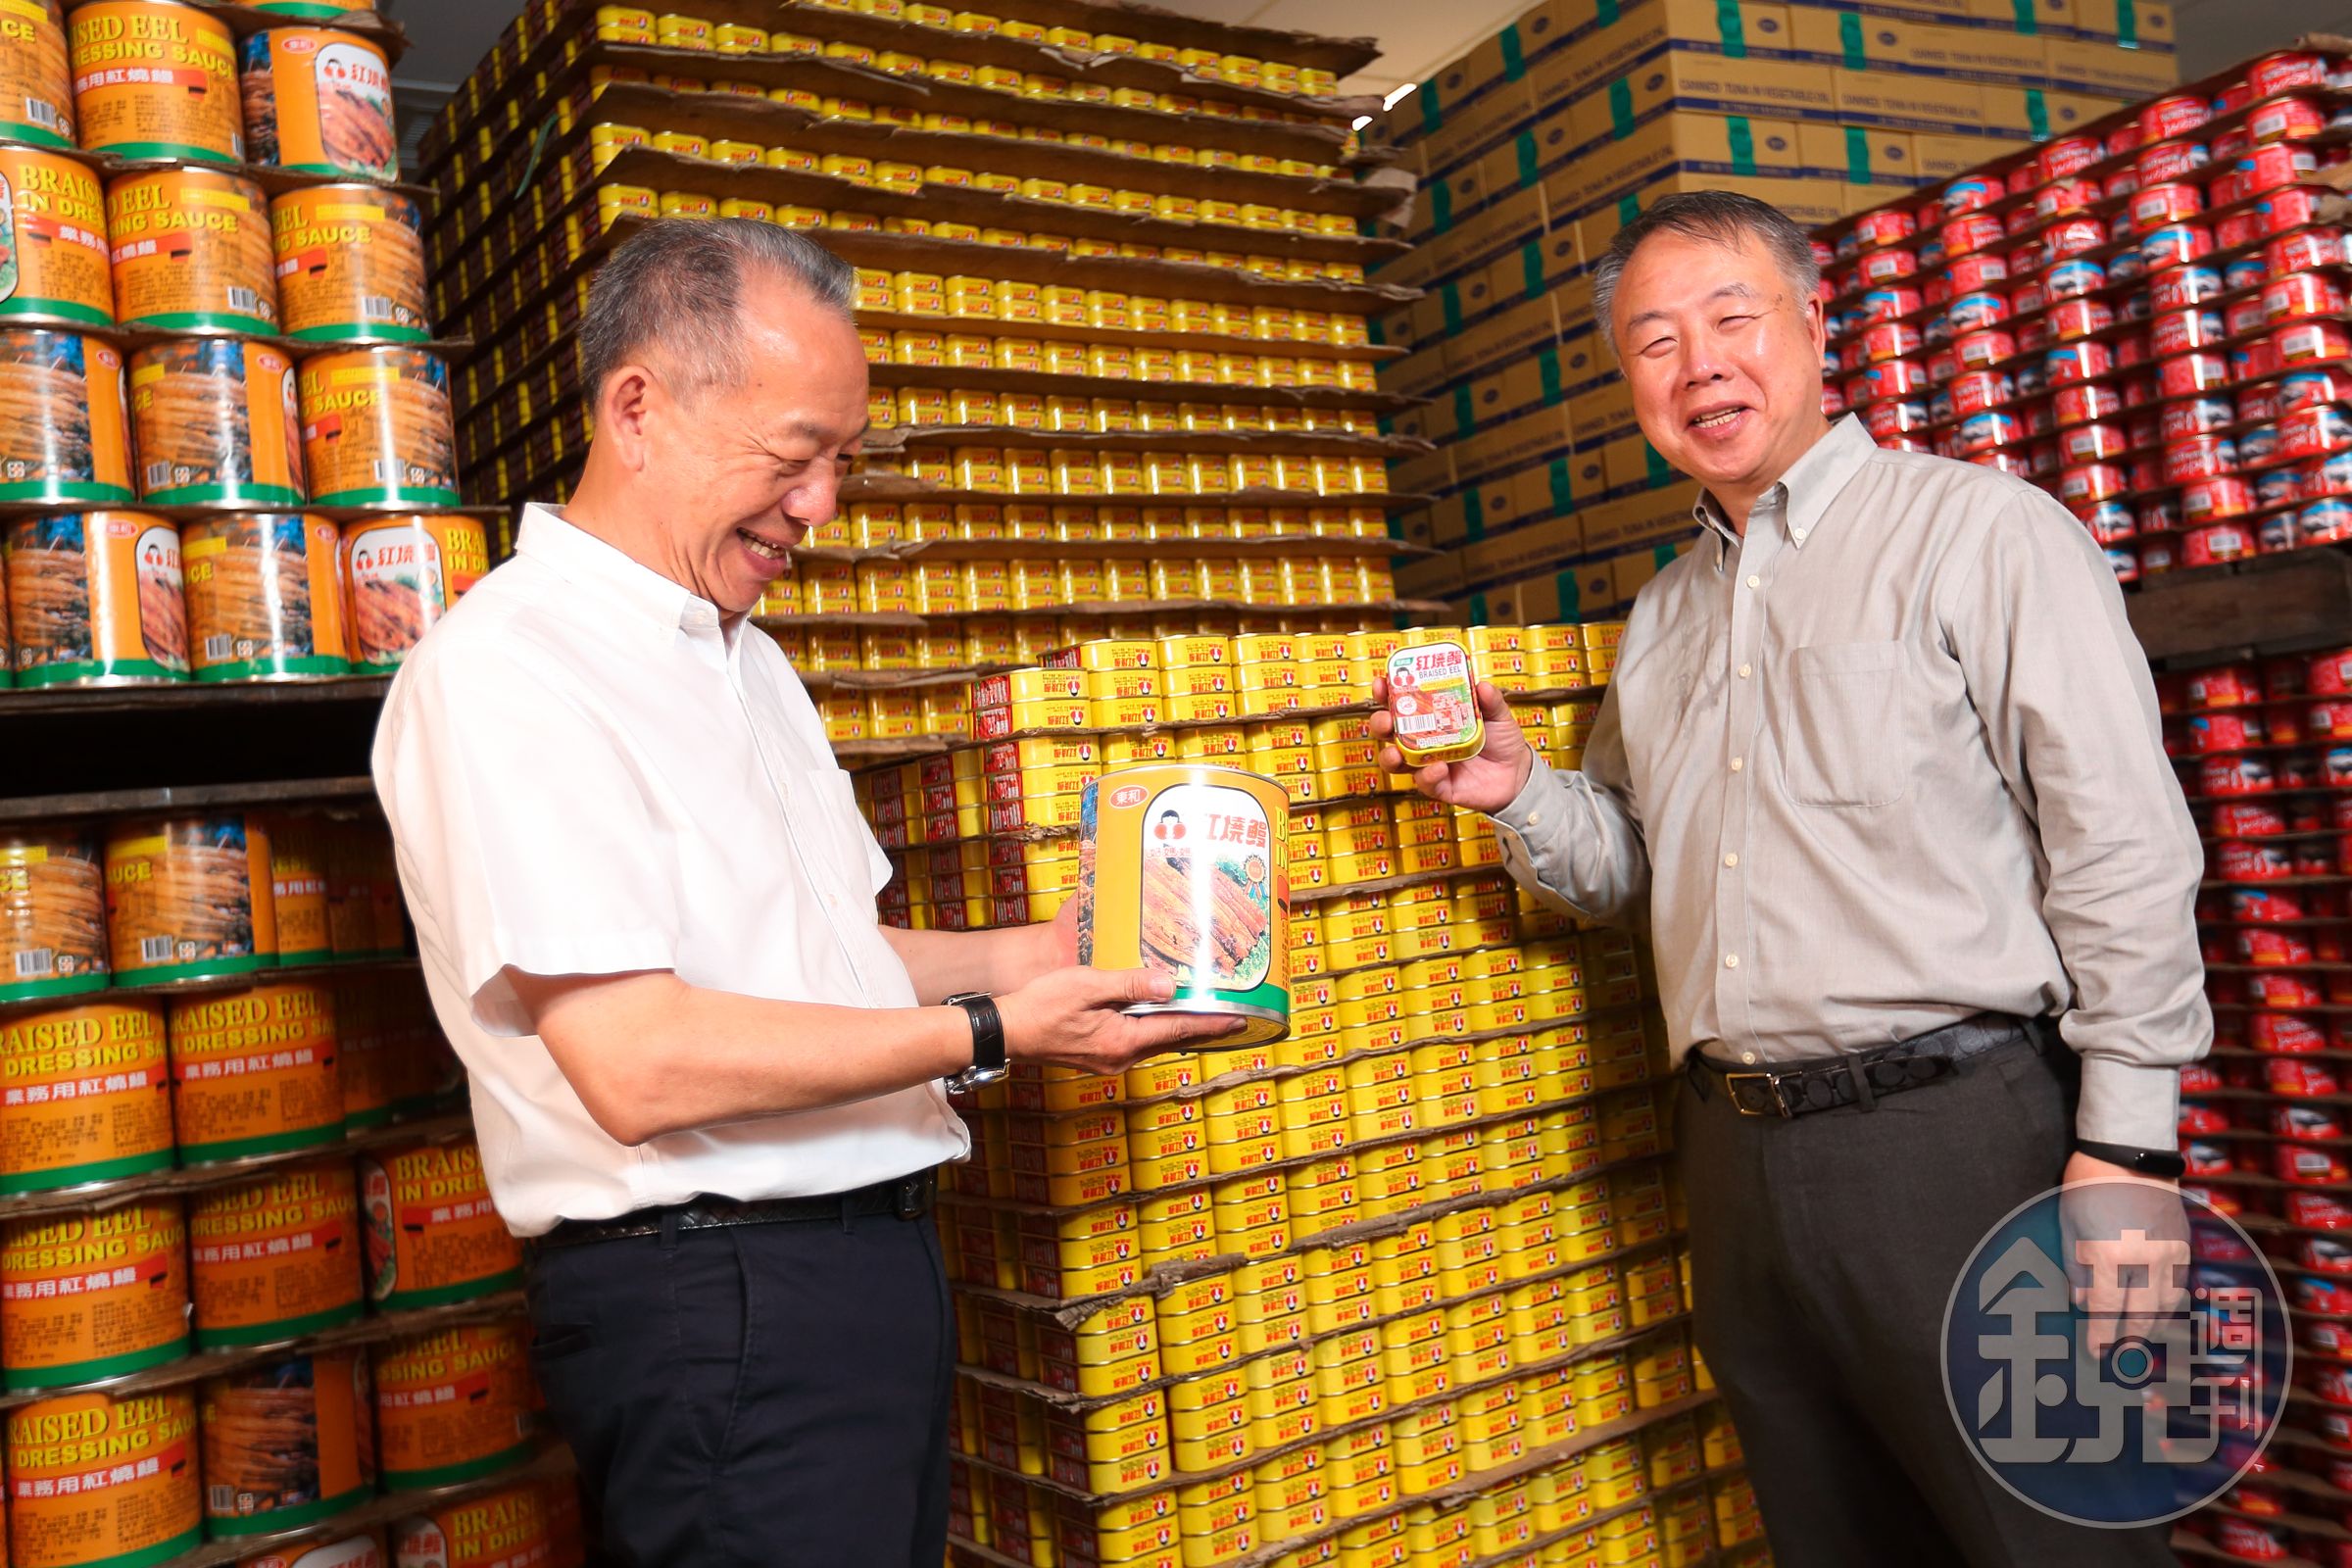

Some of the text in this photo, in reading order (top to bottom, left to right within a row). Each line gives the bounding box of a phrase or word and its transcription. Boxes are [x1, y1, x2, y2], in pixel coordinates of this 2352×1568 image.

[130, 16, 188, 44] EEL
[21, 192, 51, 213] IN
[154, 212, 238, 233] SAUCE
[296, 226, 372, 245] SAUCE
[449, 555, 467, 571] IN
[1418, 665, 1461, 679] BRAISED EEL
[1115, 788, 1141, 807] 東和
[275, 992, 321, 1020] EEL
[109, 1011, 155, 1042] EEL
[183, 1020, 305, 1054] DRESSING
[5, 1042, 139, 1077] DRESSING
[398, 1183, 424, 1202] IN
[92, 1206, 154, 1237] EEL
[116, 1396, 172, 1430] EEL
[18, 1429, 150, 1468] DRESSING
[18, 1456, 160, 1497] 業務用紅燒鰻
[454, 1540, 483, 1559] IN
